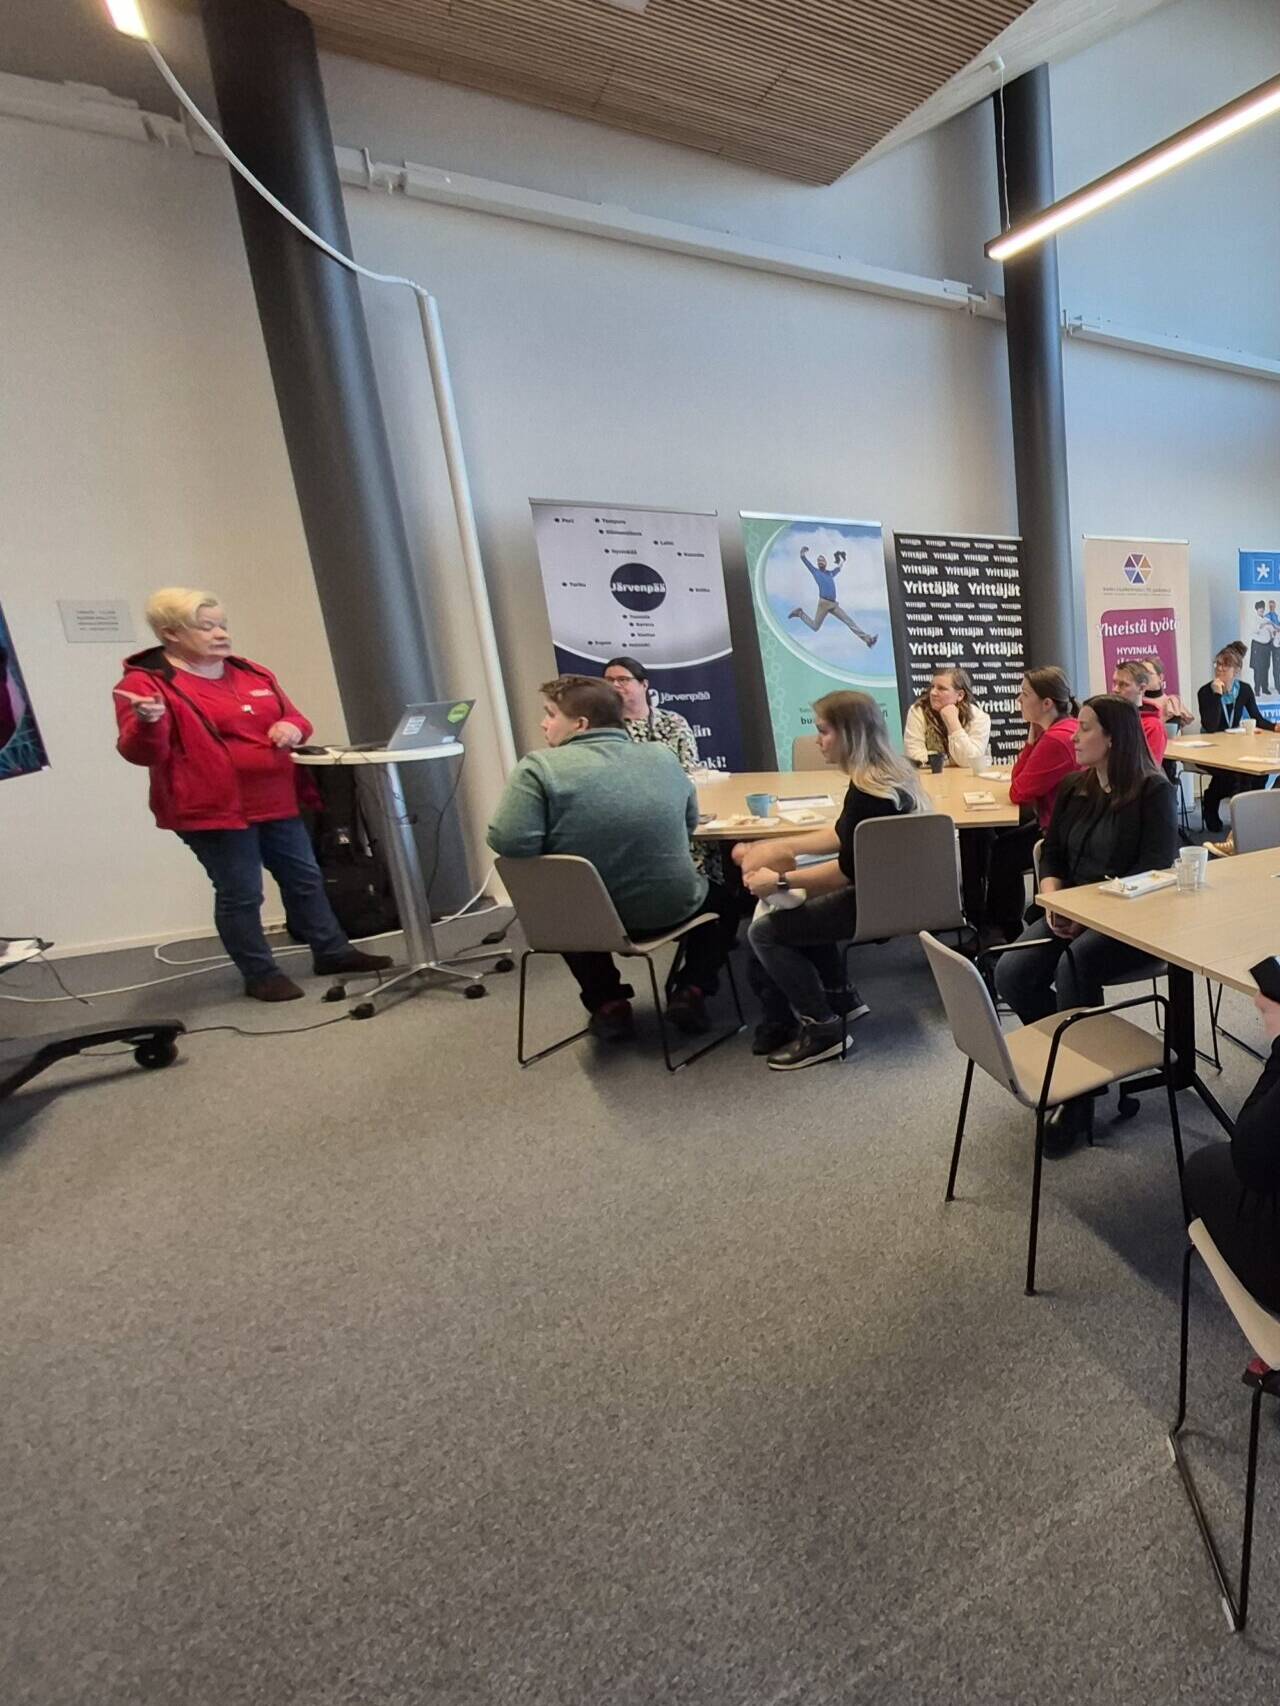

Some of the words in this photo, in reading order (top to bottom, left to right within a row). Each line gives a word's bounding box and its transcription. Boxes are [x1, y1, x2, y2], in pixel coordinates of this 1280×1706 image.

[902, 564, 939, 576] Yrittäjät
[944, 565, 979, 578] Yrittäjät
[985, 567, 1019, 579] Yrittäjät
[611, 582, 666, 594] Järvenpää
[903, 580, 960, 597] Yrittäjät
[967, 582, 1021, 599] Yrittäjät
[907, 626, 943, 638] Yrittäjät
[949, 626, 984, 638] Yrittäjät
[989, 626, 1023, 638] Yrittäjät
[1096, 617, 1148, 637] Yhteistä
[908, 642, 964, 658] Yrittäjät
[972, 641, 1024, 658] Yrittäjät
[1116, 644, 1158, 656] HYVINKÄÄ
